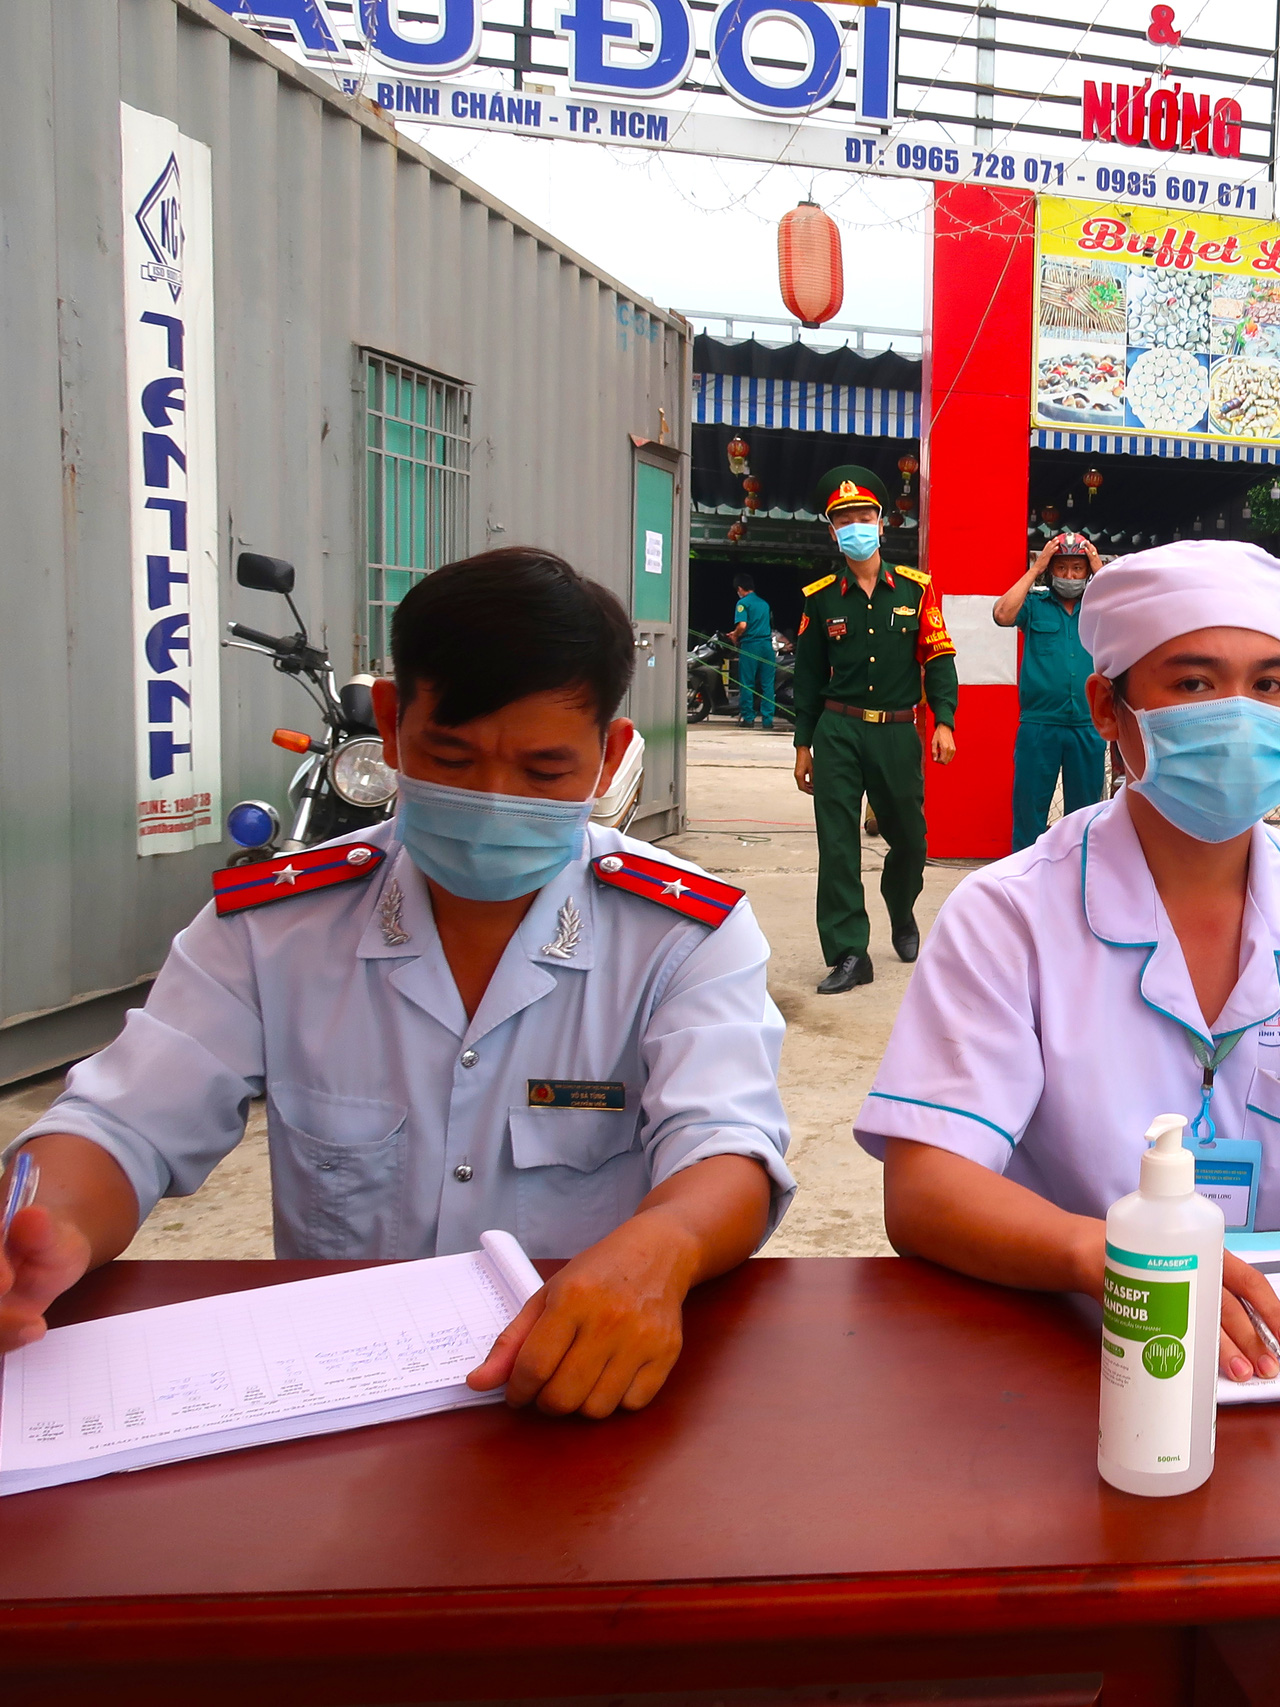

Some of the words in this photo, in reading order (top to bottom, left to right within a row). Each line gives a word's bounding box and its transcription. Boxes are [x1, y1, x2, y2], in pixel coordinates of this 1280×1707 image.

[1145, 4, 1182, 47] &
[377, 80, 440, 116] BÌNH
[451, 91, 542, 128] CHÁNH
[566, 105, 602, 134] TP.
[610, 109, 668, 142] HCM
[1081, 66, 1243, 159] NƯỚNG
[845, 137, 886, 166] ĐT:
[896, 143, 959, 175] 0965
[972, 151, 1015, 180] 728
[1024, 158, 1065, 187] 071
[1096, 167, 1156, 198] 0985
[1165, 176, 1208, 204] 607
[1217, 181, 1257, 210] 671
[1077, 216, 1242, 271] Buffet
